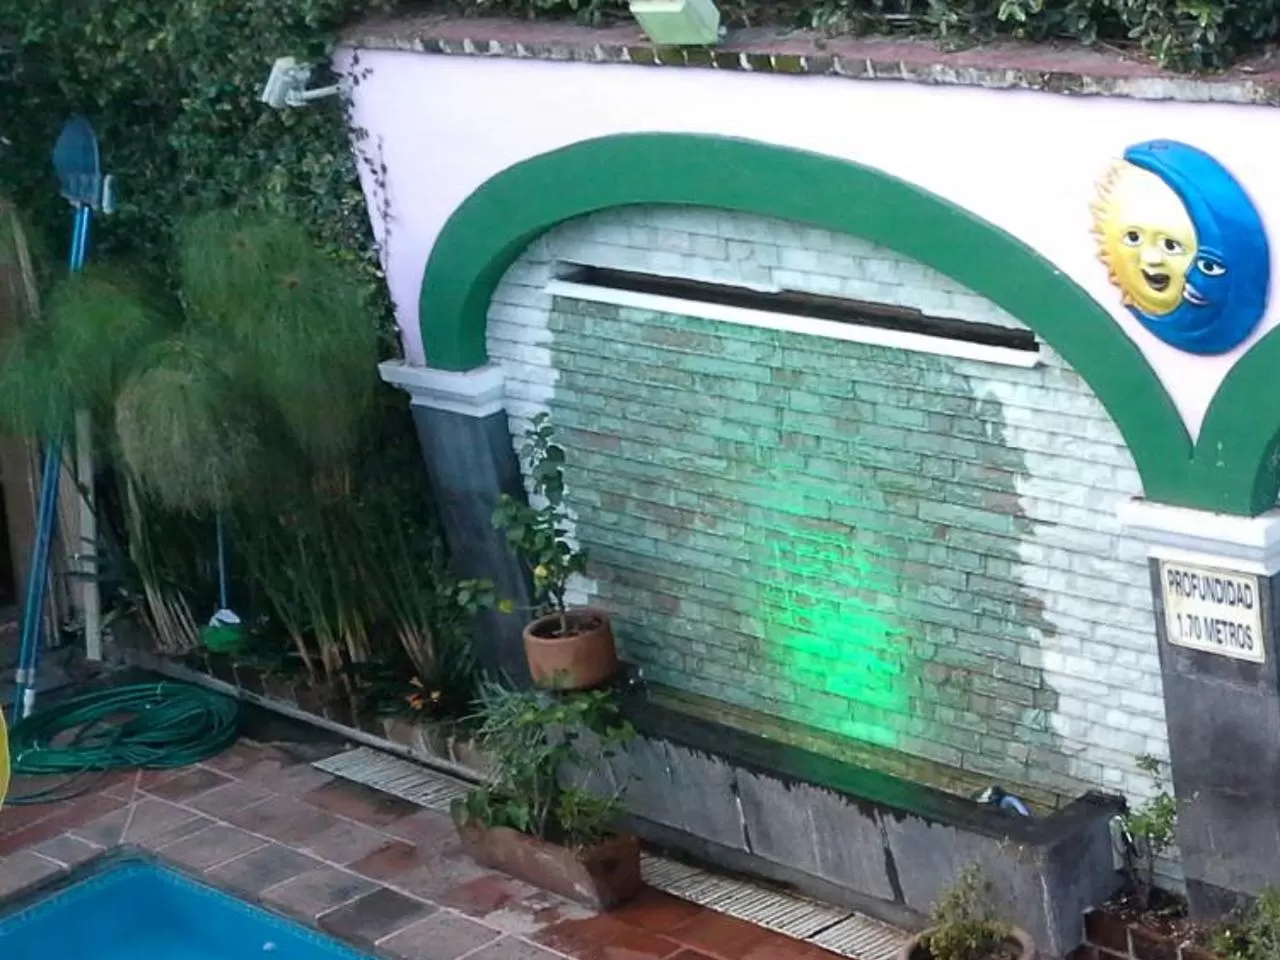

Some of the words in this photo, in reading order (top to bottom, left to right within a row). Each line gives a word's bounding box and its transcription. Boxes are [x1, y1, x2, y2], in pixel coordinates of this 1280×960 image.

[1167, 569, 1254, 610] PROFUNDIDAD
[1177, 613, 1202, 640] 1.70
[1204, 616, 1254, 651] METROS
